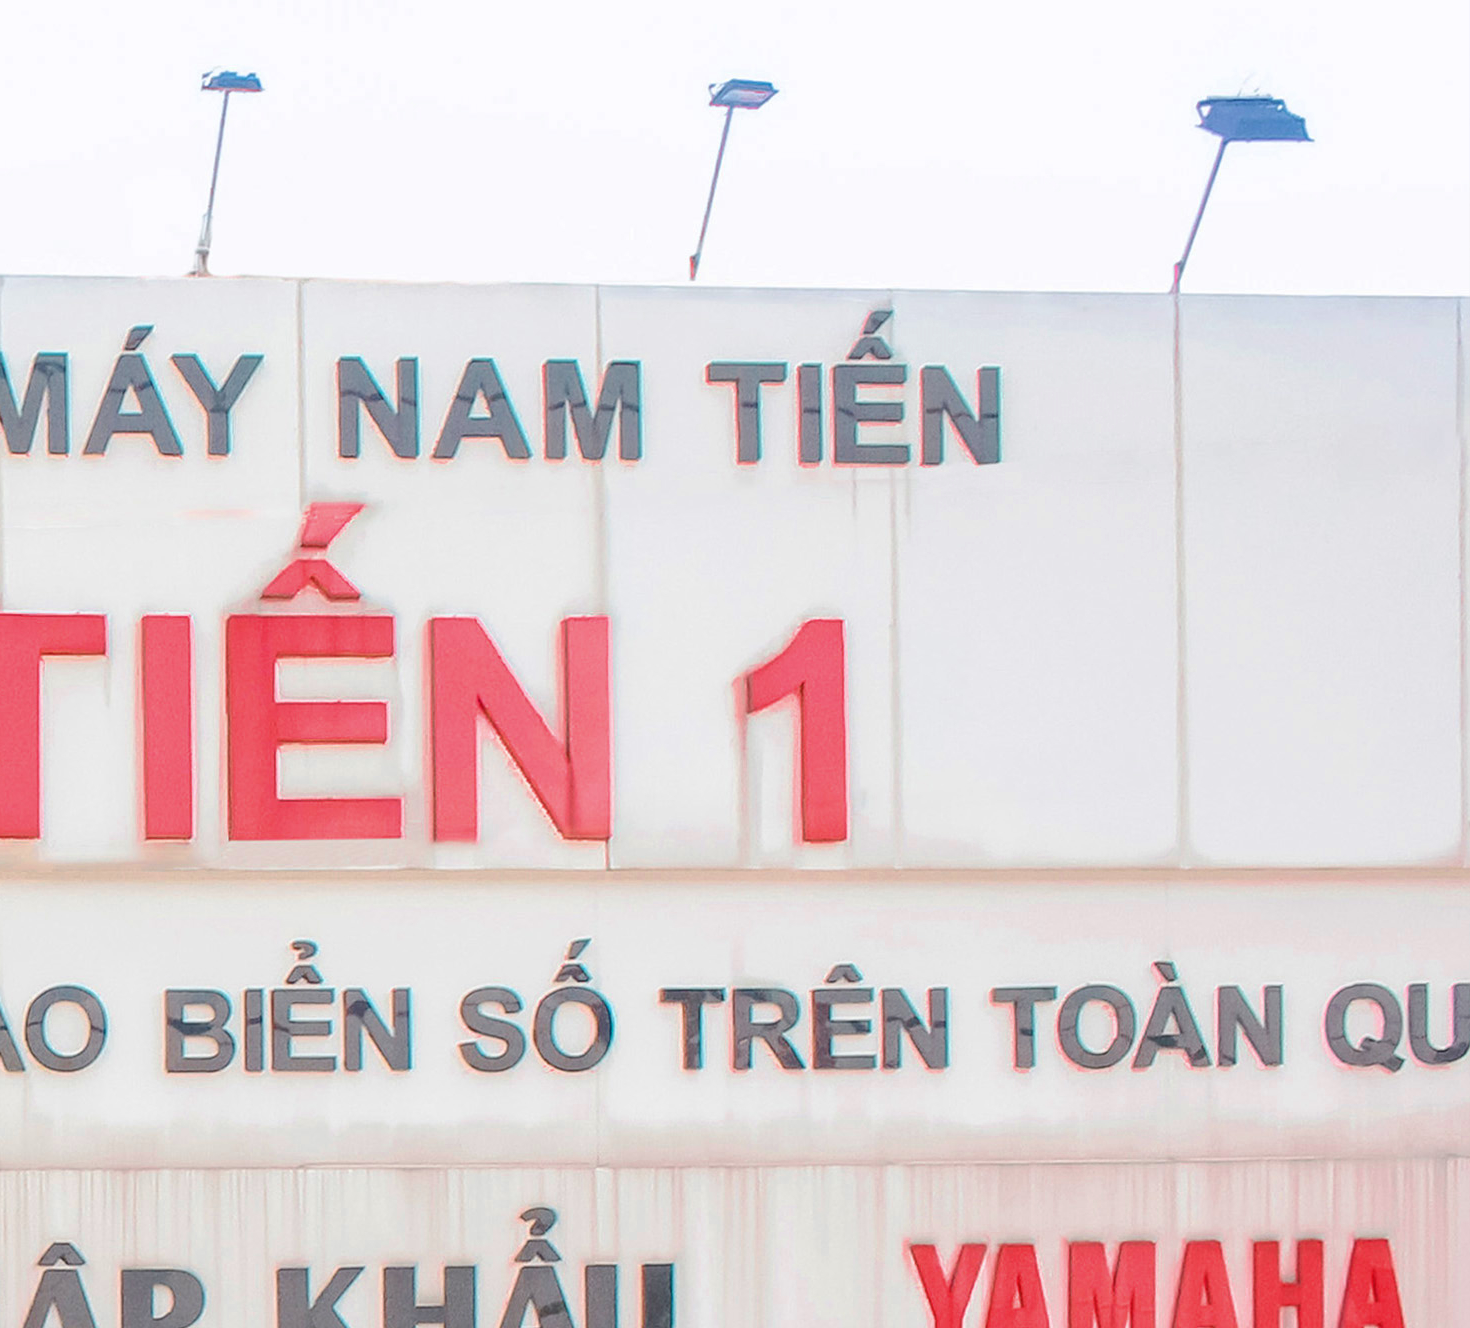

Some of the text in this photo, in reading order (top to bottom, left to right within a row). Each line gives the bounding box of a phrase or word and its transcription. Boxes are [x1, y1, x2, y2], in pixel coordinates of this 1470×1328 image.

[337, 356, 642, 460] NAM
[706, 311, 1002, 466] TIẾN
[744, 618, 848, 842] 1
[163, 939, 413, 1074] BIỂN
[459, 937, 615, 1074] SỐ
[659, 963, 950, 1073] TRÊN
[991, 960, 1284, 1073] TOÀN
